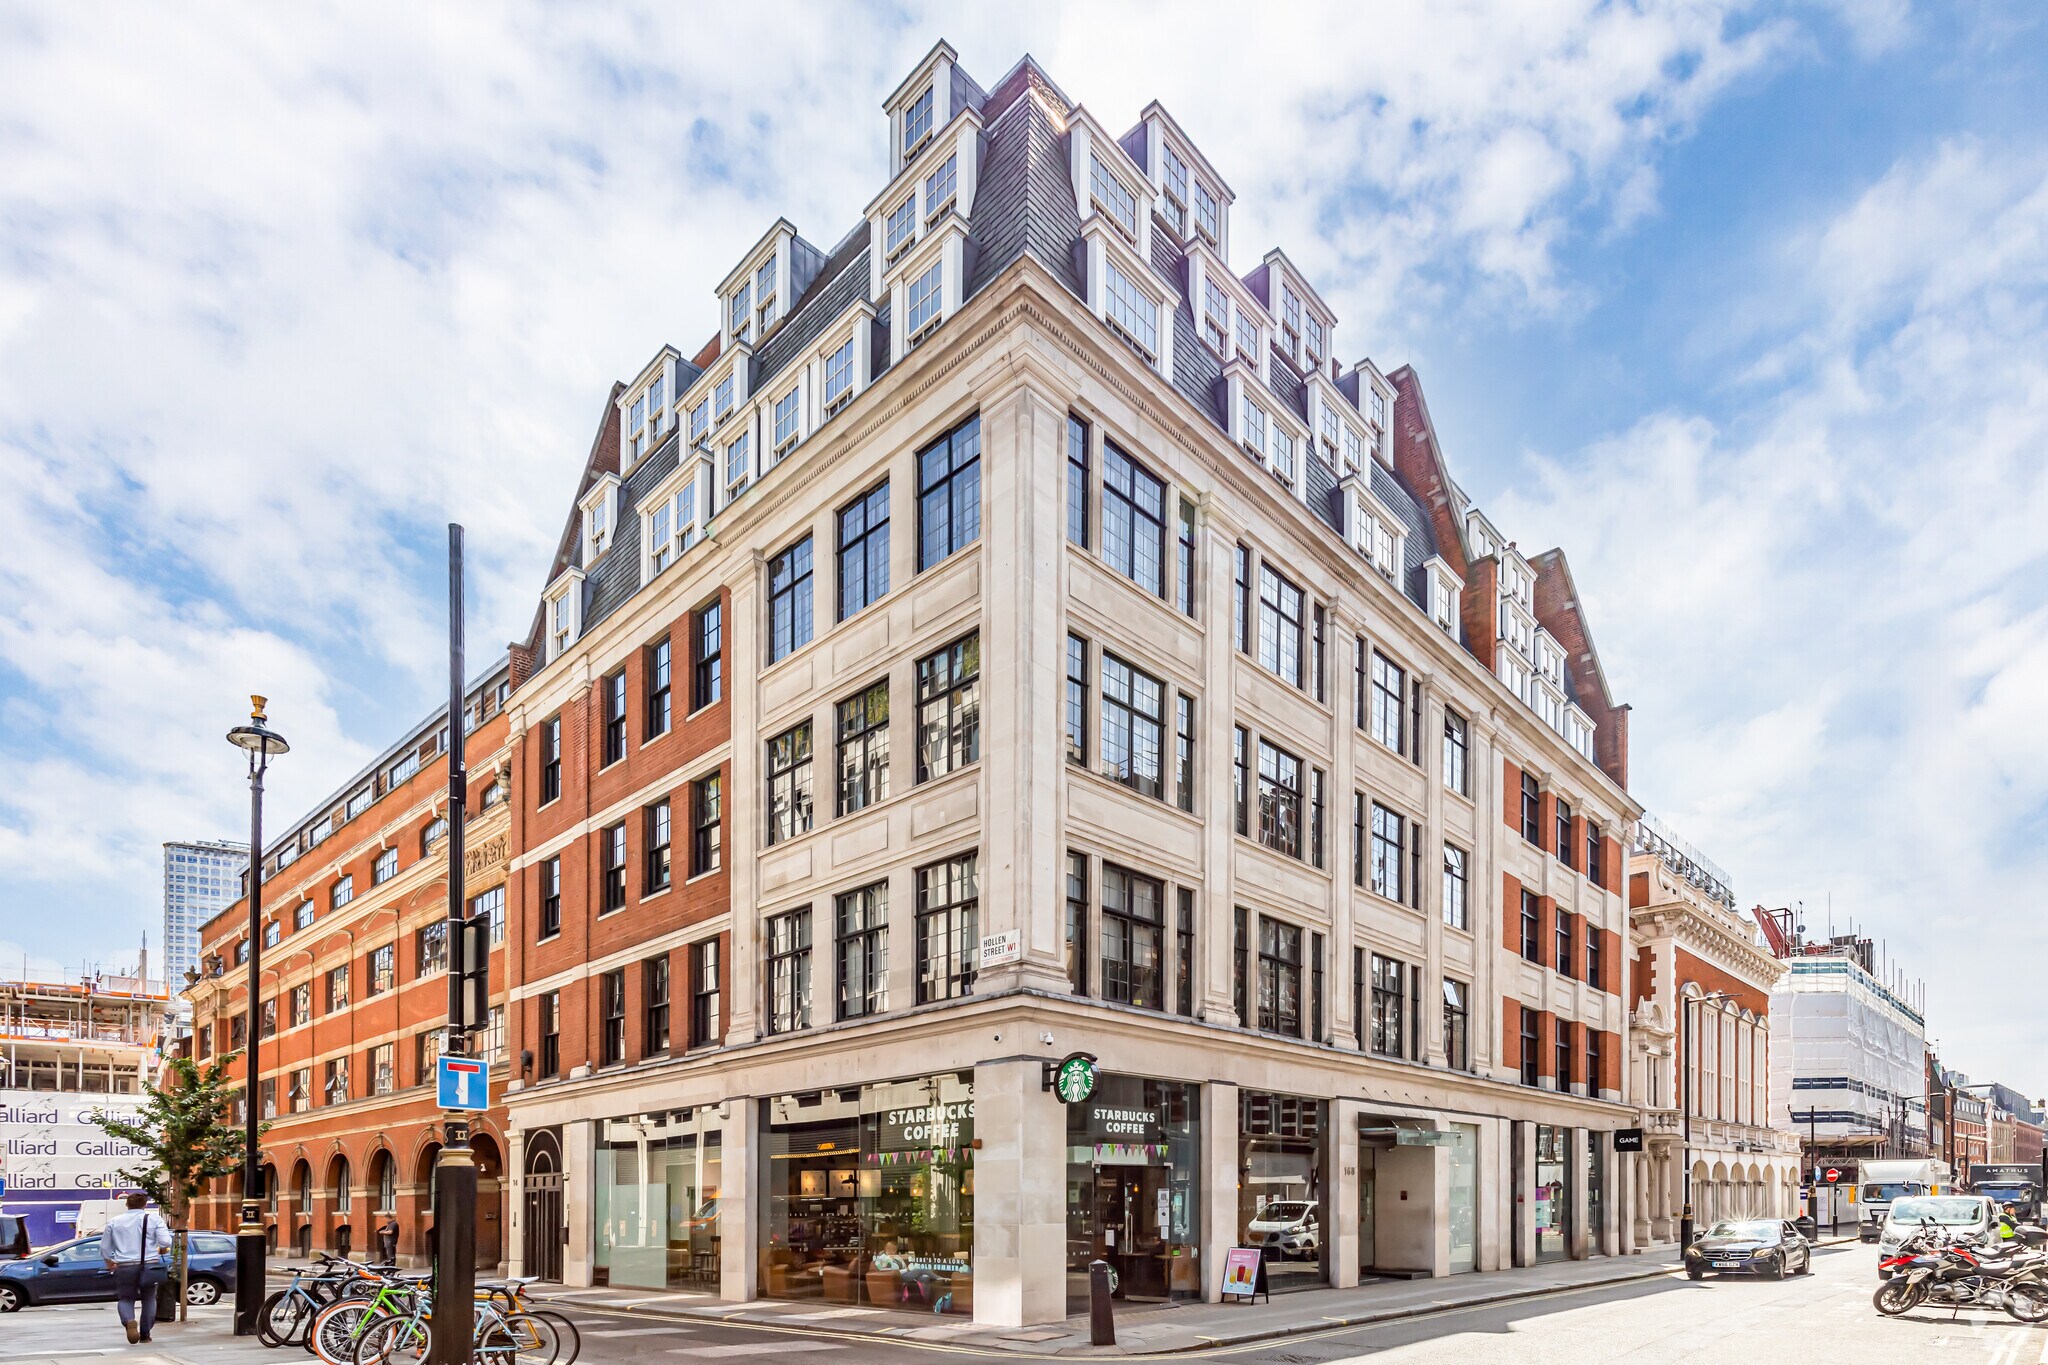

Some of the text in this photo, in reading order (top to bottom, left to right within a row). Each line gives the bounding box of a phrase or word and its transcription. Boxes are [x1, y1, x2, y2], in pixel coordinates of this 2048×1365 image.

[984, 935, 1006, 948] HOLLEN
[984, 942, 1016, 957] STREET W1
[0, 1108, 58, 1124] alliard
[77, 1111, 145, 1125] Glliar
[888, 1102, 974, 1125] STARBUCKS
[1093, 1108, 1155, 1122] STARBUCKS
[903, 1122, 959, 1141] COFFEE
[1105, 1122, 1145, 1134] COFFEE
[8, 1139, 57, 1155] lliard
[5, 1173, 56, 1188] lliard
[74, 1173, 134, 1188] Galliar
